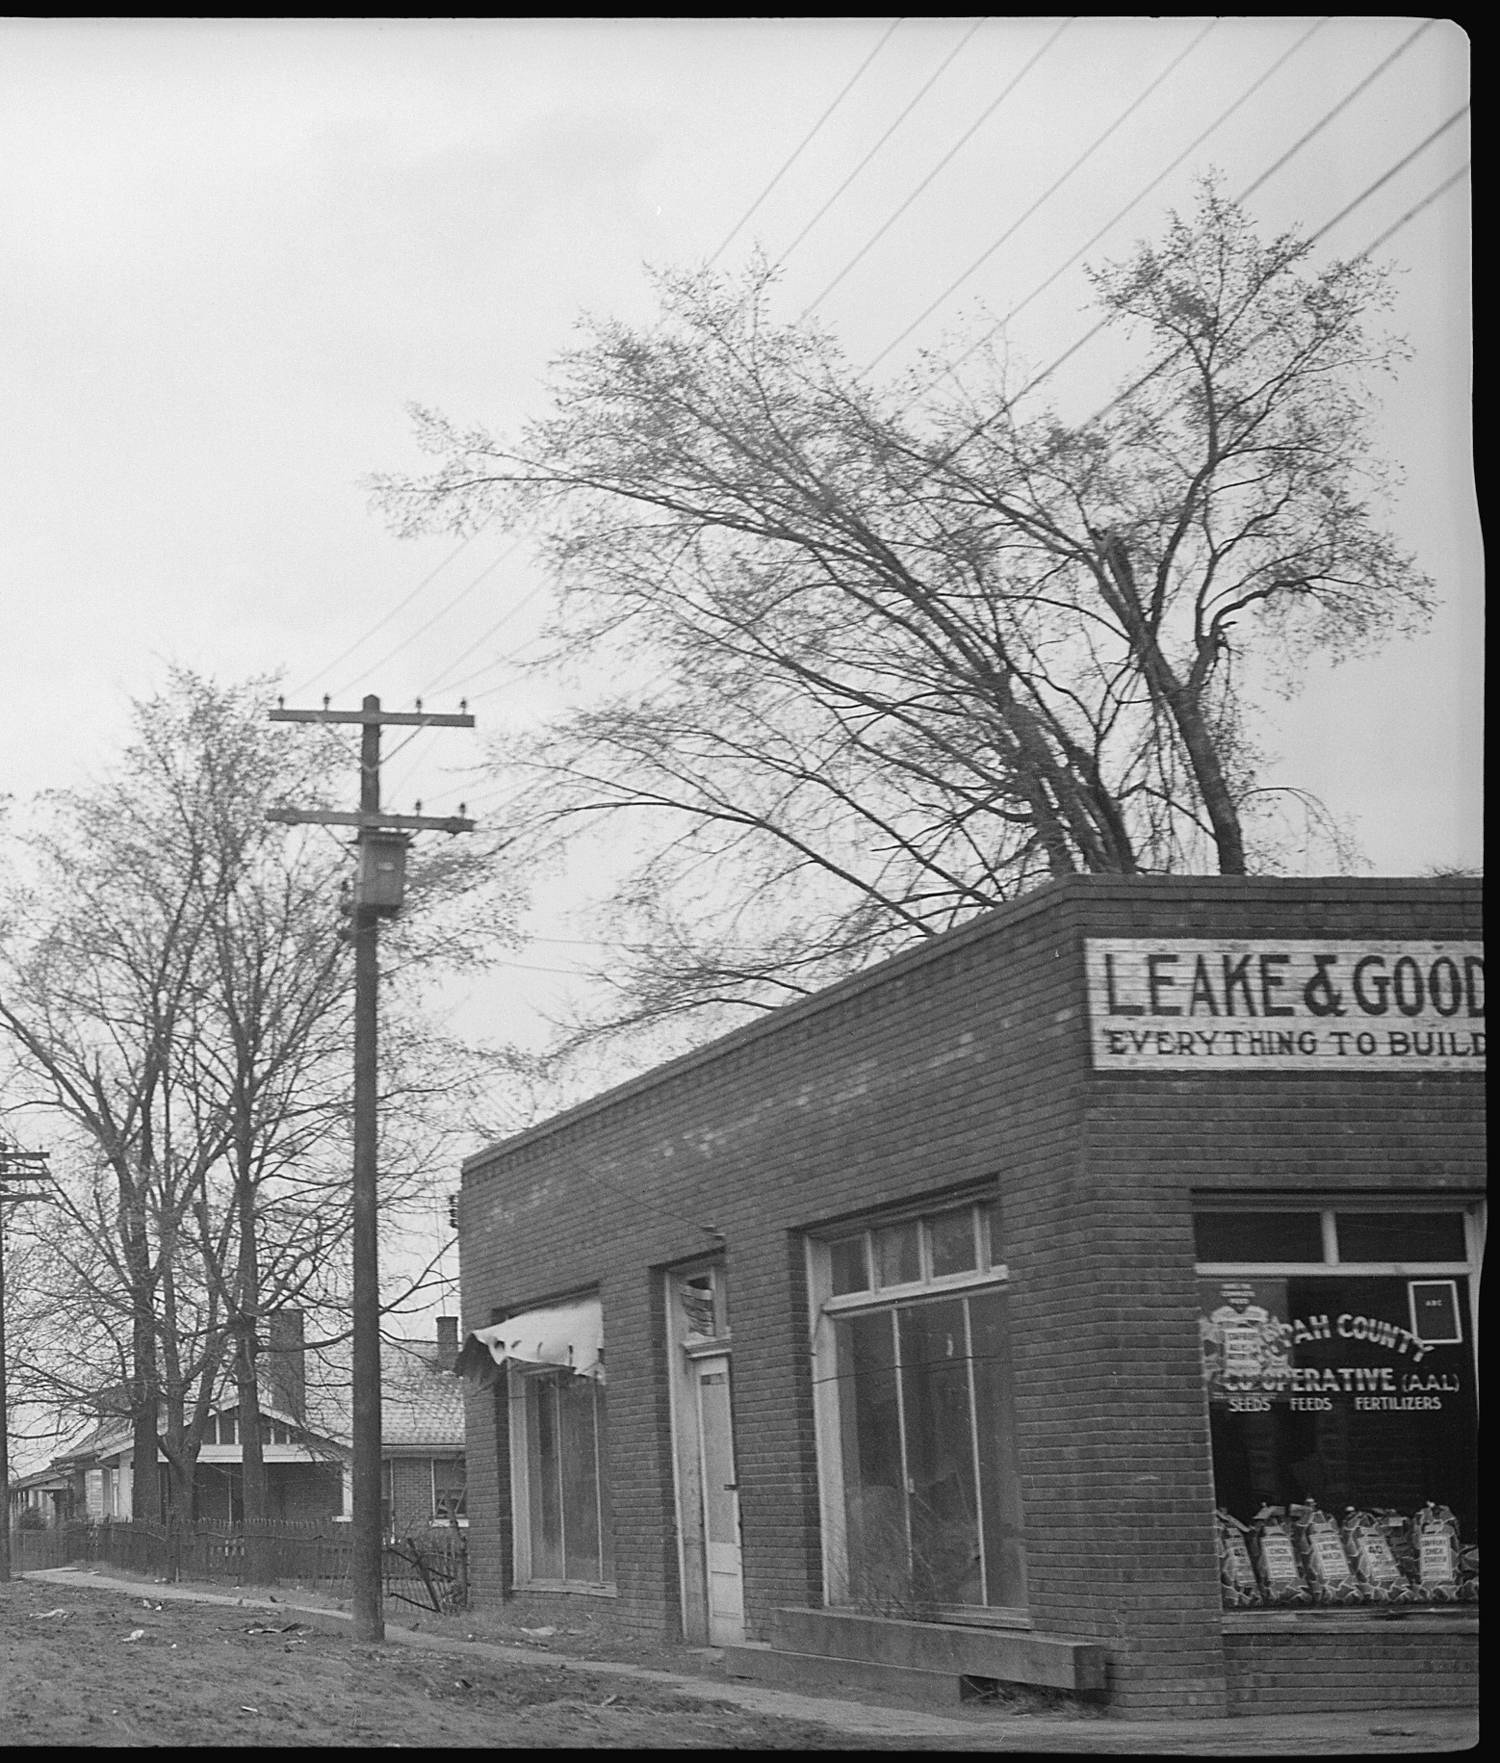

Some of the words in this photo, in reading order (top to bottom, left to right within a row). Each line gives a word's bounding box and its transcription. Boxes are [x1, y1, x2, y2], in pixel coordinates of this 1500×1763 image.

[1105, 953, 1295, 1017] LEAKE
[1303, 954, 1346, 1017] &
[1107, 1029, 1317, 1057] EVERYTHING
[1329, 1031, 1376, 1056] TO
[1337, 1313, 1435, 1363] COUNTY
[1228, 1398, 1272, 1412] SEEDS
[1290, 1397, 1333, 1411] FEEDS
[1355, 1396, 1443, 1411] FERTILIZERS
